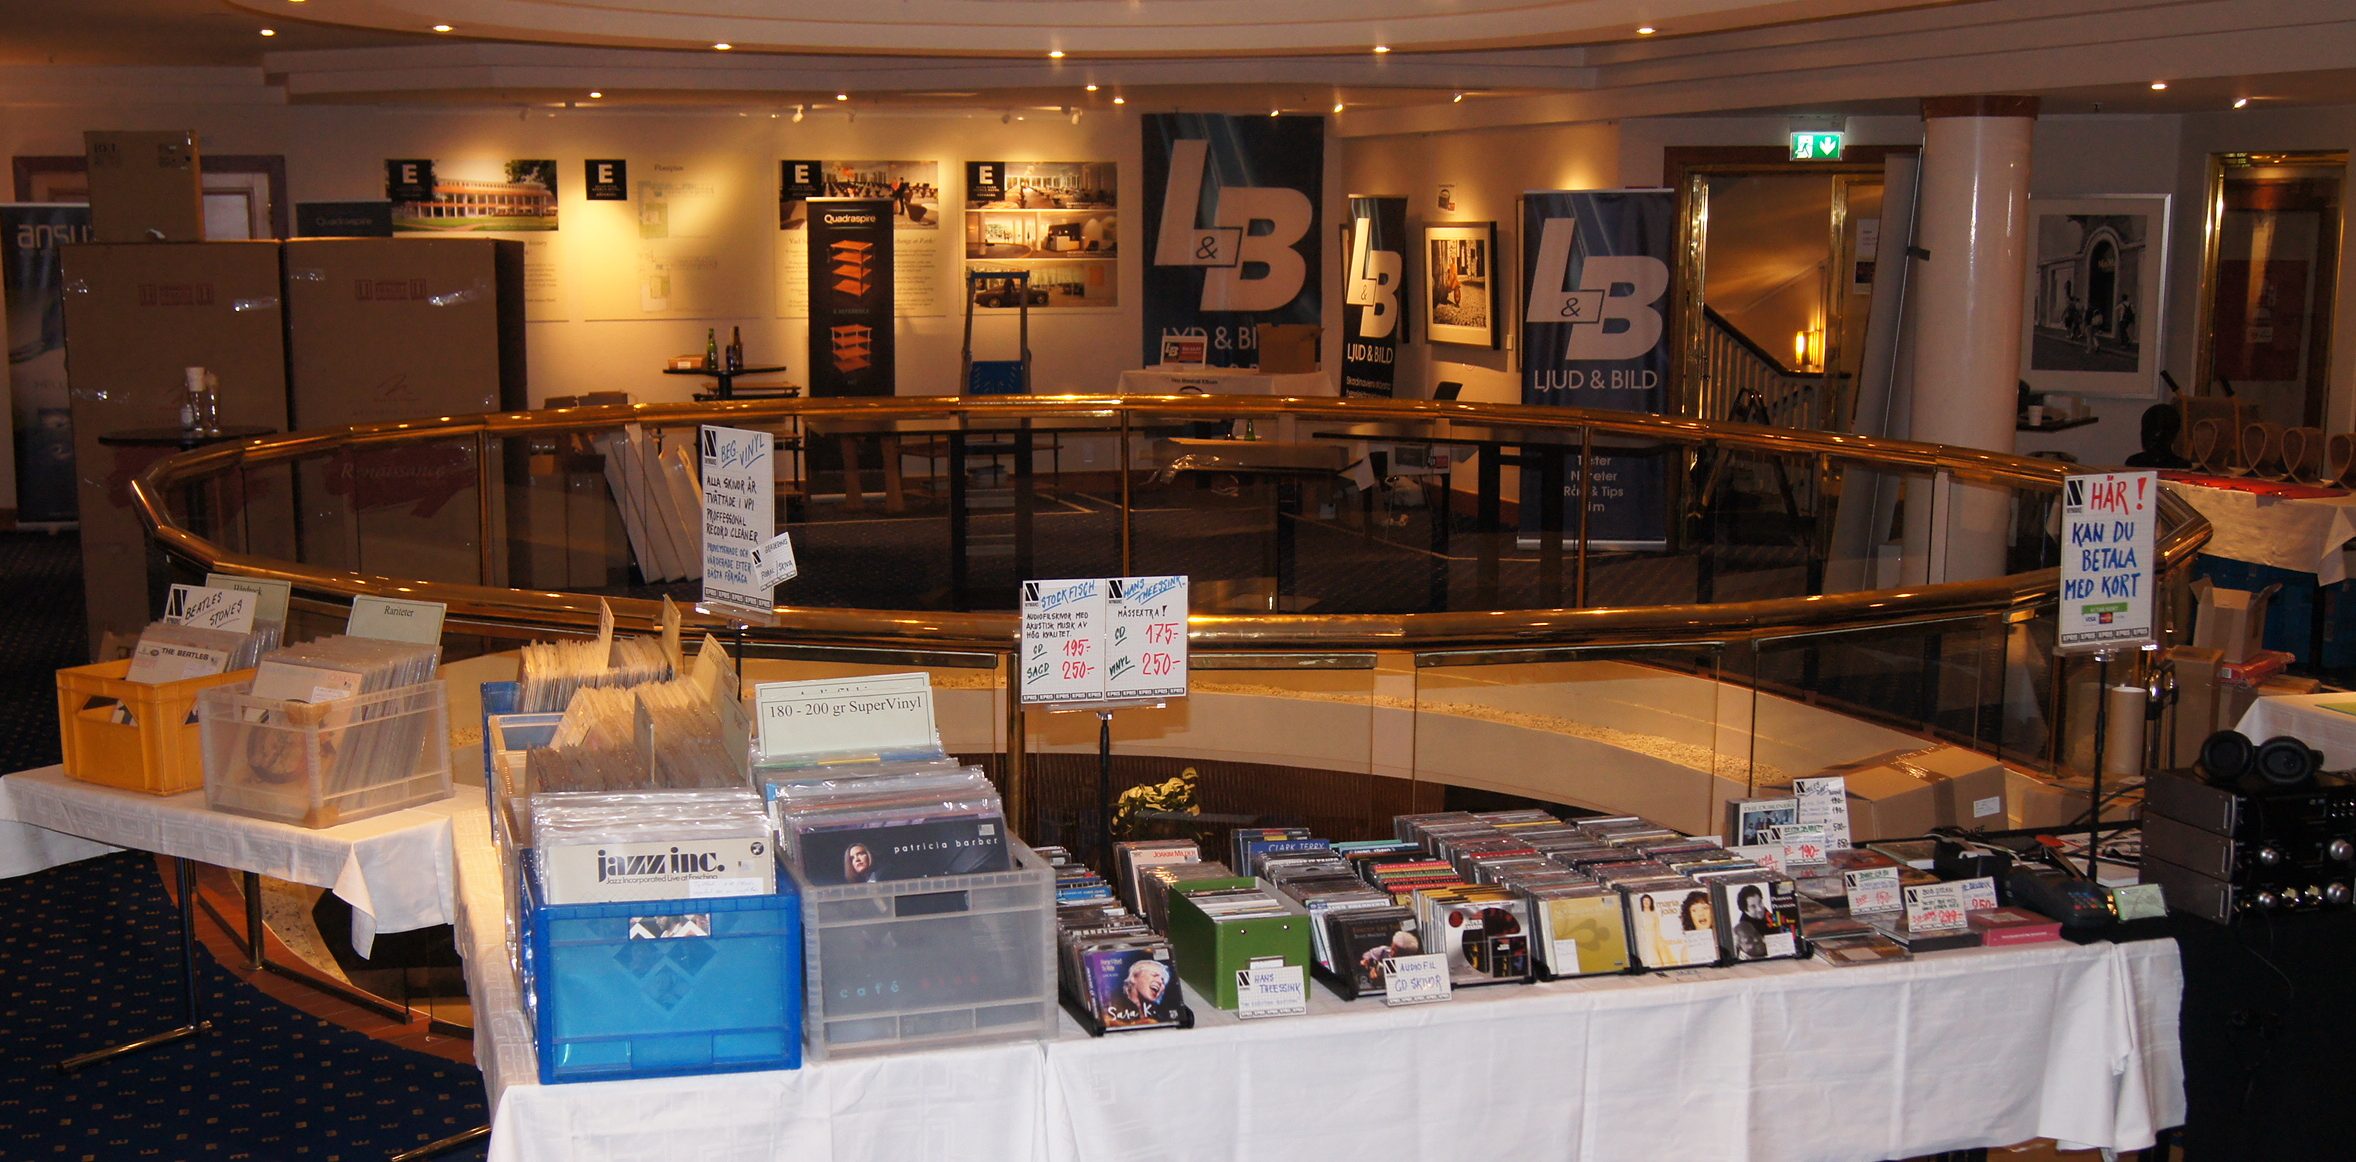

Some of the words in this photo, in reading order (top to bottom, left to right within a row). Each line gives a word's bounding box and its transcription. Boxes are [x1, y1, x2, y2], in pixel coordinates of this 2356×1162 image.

[402, 164, 418, 184] E
[598, 164, 614, 184] E
[795, 164, 809, 184] E
[979, 165, 994, 185] E
[824, 214, 876, 224] Quadraspire
[1215, 326, 1232, 350] &
[1348, 343, 1366, 362] LJUD
[1367, 345, 1374, 362] &
[1374, 346, 1393, 364] BILD
[1534, 369, 1584, 393] LJUD
[1590, 369, 1605, 390] &
[1612, 369, 1658, 390] BILD
[721, 440, 736, 463] BEG
[740, 434, 765, 465] VINYL
[706, 475, 721, 488] ALLA
[723, 478, 745, 494] SKIVOR
[1602, 486, 1624, 499] Tips
[2090, 475, 2129, 515] HÄR
[706, 523, 728, 539] RECORD
[730, 527, 759, 545] CLEANER
[2072, 522, 2104, 547] KAN
[2113, 521, 2134, 543] DU
[2082, 547, 2137, 572] BETALA
[1124, 578, 1145, 598] HANS
[2064, 579, 2094, 600] MED
[2102, 572, 2141, 598] KORT
[185, 592, 222, 620] BEATLES
[210, 599, 243, 626] STONES
[1075, 611, 1089, 619] MED
[1115, 626, 1126, 640] CD
[177, 649, 209, 660] BEATLES
[1033, 643, 1044, 655] CD
[1027, 662, 1050, 679] SACD
[1109, 655, 1131, 676] VINYL
[770, 704, 793, 719] 180
[806, 702, 829, 716] 200
[833, 704, 847, 717] gr
[849, 696, 922, 714] SuperVinyl
[894, 841, 948, 854] patricia
[955, 837, 1000, 848] barber
[1268, 843, 1296, 852] CLARK
[1300, 842, 1326, 850] TERRY
[598, 849, 666, 883] jazz
[670, 846, 725, 873] inc.
[607, 877, 622, 885] Jazz
[623, 874, 667, 884] Incorporated
[668, 874, 679, 882] Live
[1255, 973, 1274, 984] HANS
[1395, 979, 1408, 992] CD
[840, 980, 899, 999] café
[1107, 1006, 1138, 1020] Sara
[1143, 1001, 1156, 1018] K.
